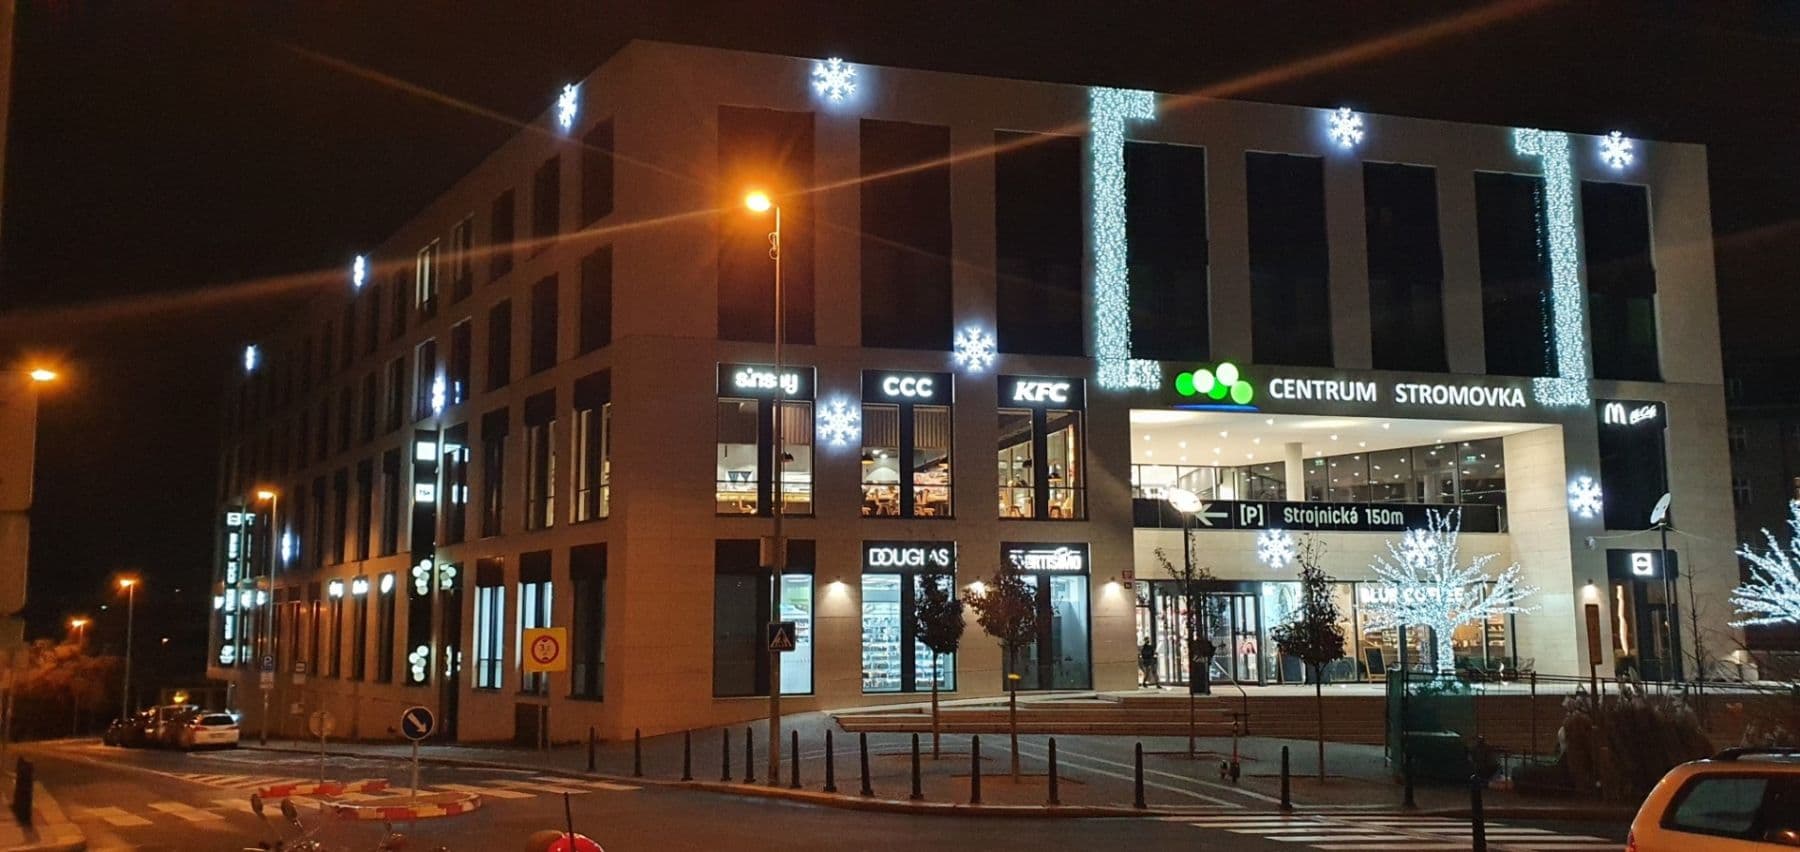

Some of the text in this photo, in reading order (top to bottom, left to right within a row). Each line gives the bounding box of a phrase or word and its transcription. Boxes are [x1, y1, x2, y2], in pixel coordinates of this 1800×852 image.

[882, 376, 933, 397] CCC
[1013, 381, 1070, 403] KFC
[1269, 378, 1526, 408] CENTRUM STROMOVKA
[1283, 506, 1358, 527] Strojnická
[1365, 508, 1404, 525] 150m
